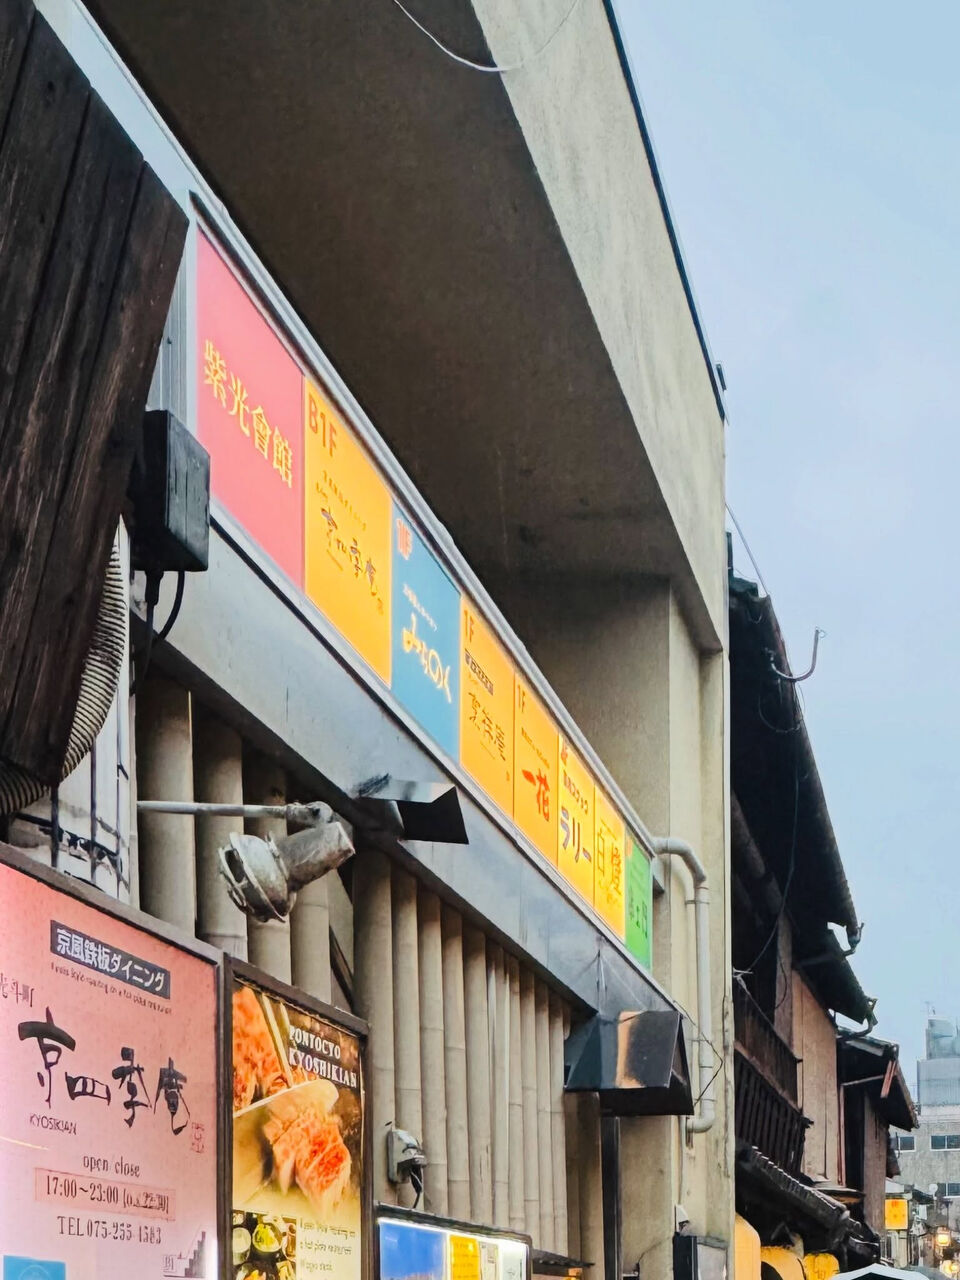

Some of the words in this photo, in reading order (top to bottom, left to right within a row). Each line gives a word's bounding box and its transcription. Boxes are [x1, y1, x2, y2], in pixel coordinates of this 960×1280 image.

[204, 339, 293, 488] 紫光會館
[308, 391, 338, 458] B1F
[463, 609, 476, 643] 1F
[517, 684, 526, 713] 1F
[521, 768, 550, 823] 一花
[560, 805, 592, 864] ラリー
[56, 928, 166, 992] 京風鉄板ダイニング
[289, 1047, 357, 1089] KYOSHIKIAN
[83, 1155, 109, 1173] open
[115, 1155, 140, 1178] close
[57, 1215, 84, 1237] TEL
